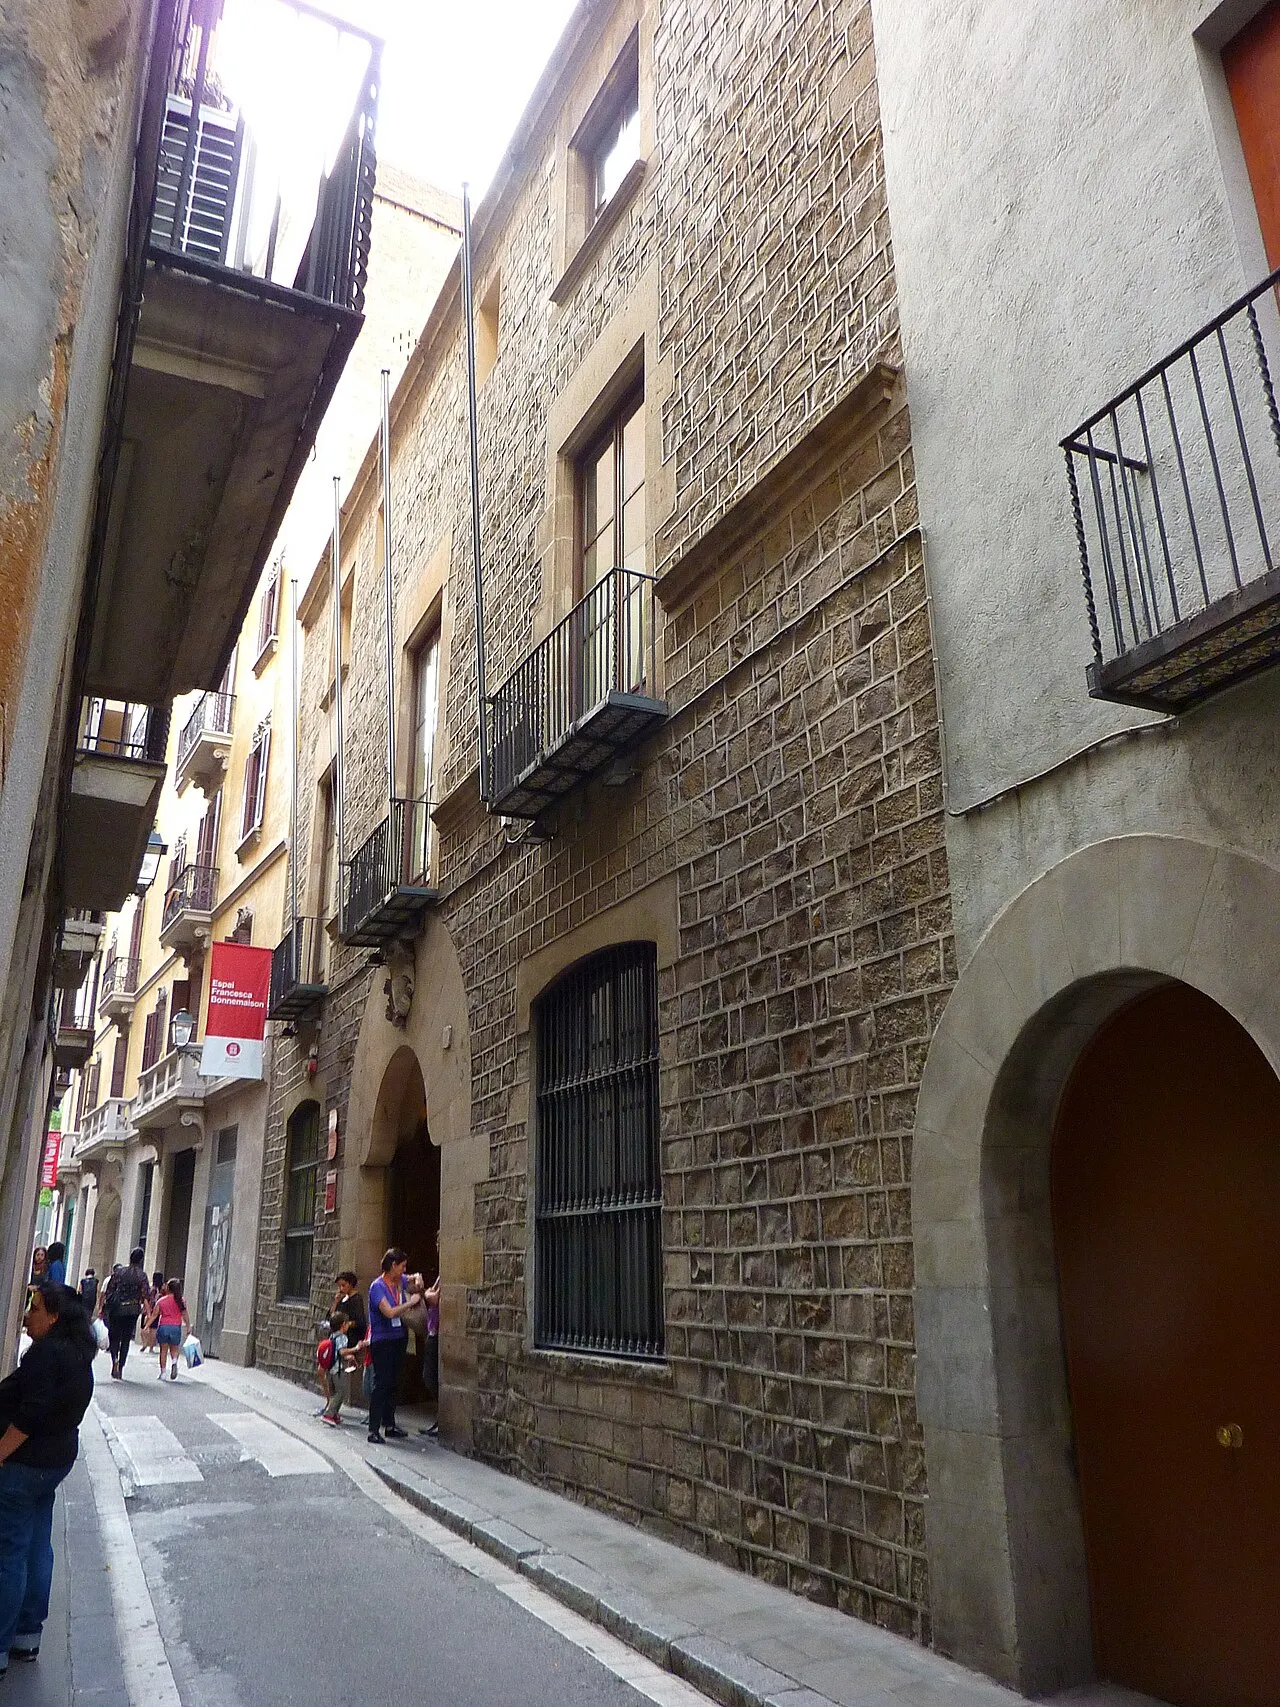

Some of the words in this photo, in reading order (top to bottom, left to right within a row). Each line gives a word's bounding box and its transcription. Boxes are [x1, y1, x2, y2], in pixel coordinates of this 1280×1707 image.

[212, 979, 235, 989] Espai
[211, 988, 253, 999] Francesca
[210, 995, 264, 1008] Bonnemaison
